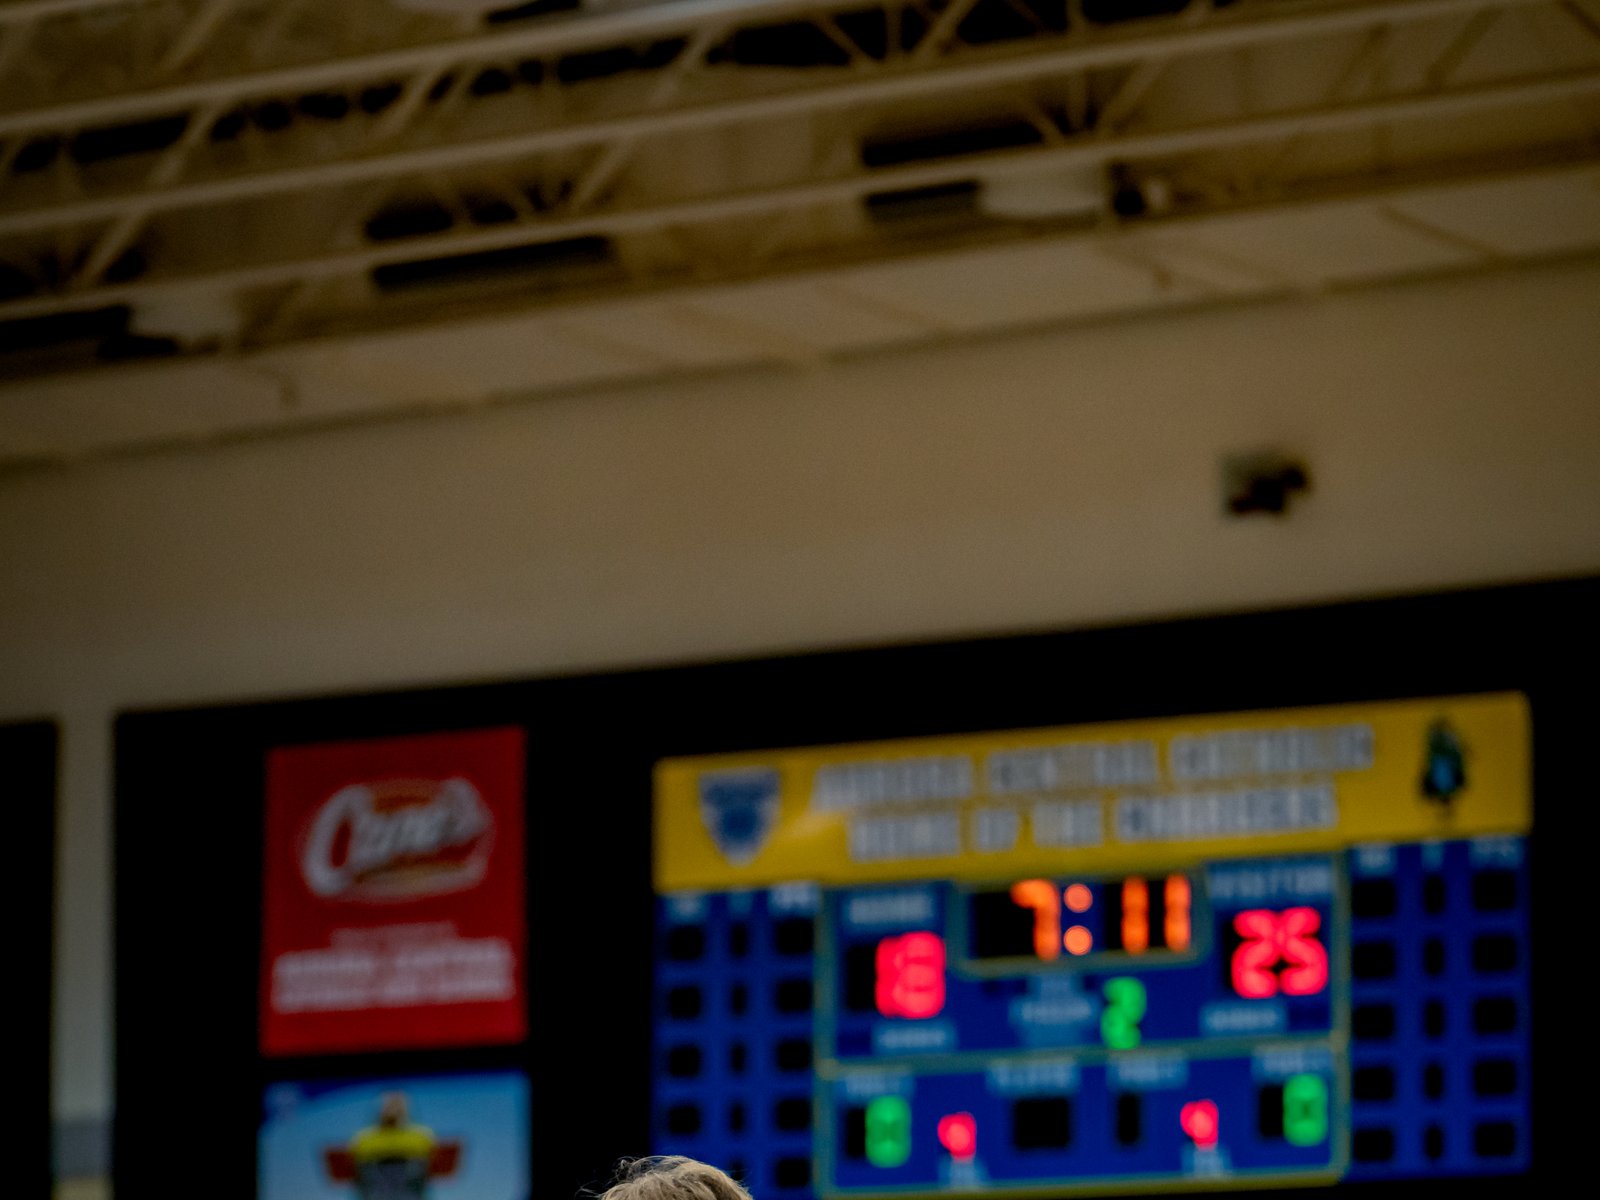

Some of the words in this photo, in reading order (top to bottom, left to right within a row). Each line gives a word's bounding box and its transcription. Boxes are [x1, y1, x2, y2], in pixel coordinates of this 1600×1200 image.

[1010, 873, 1192, 961] 7:11
[1230, 905, 1329, 999] 25
[1100, 976, 1148, 1051] 2
